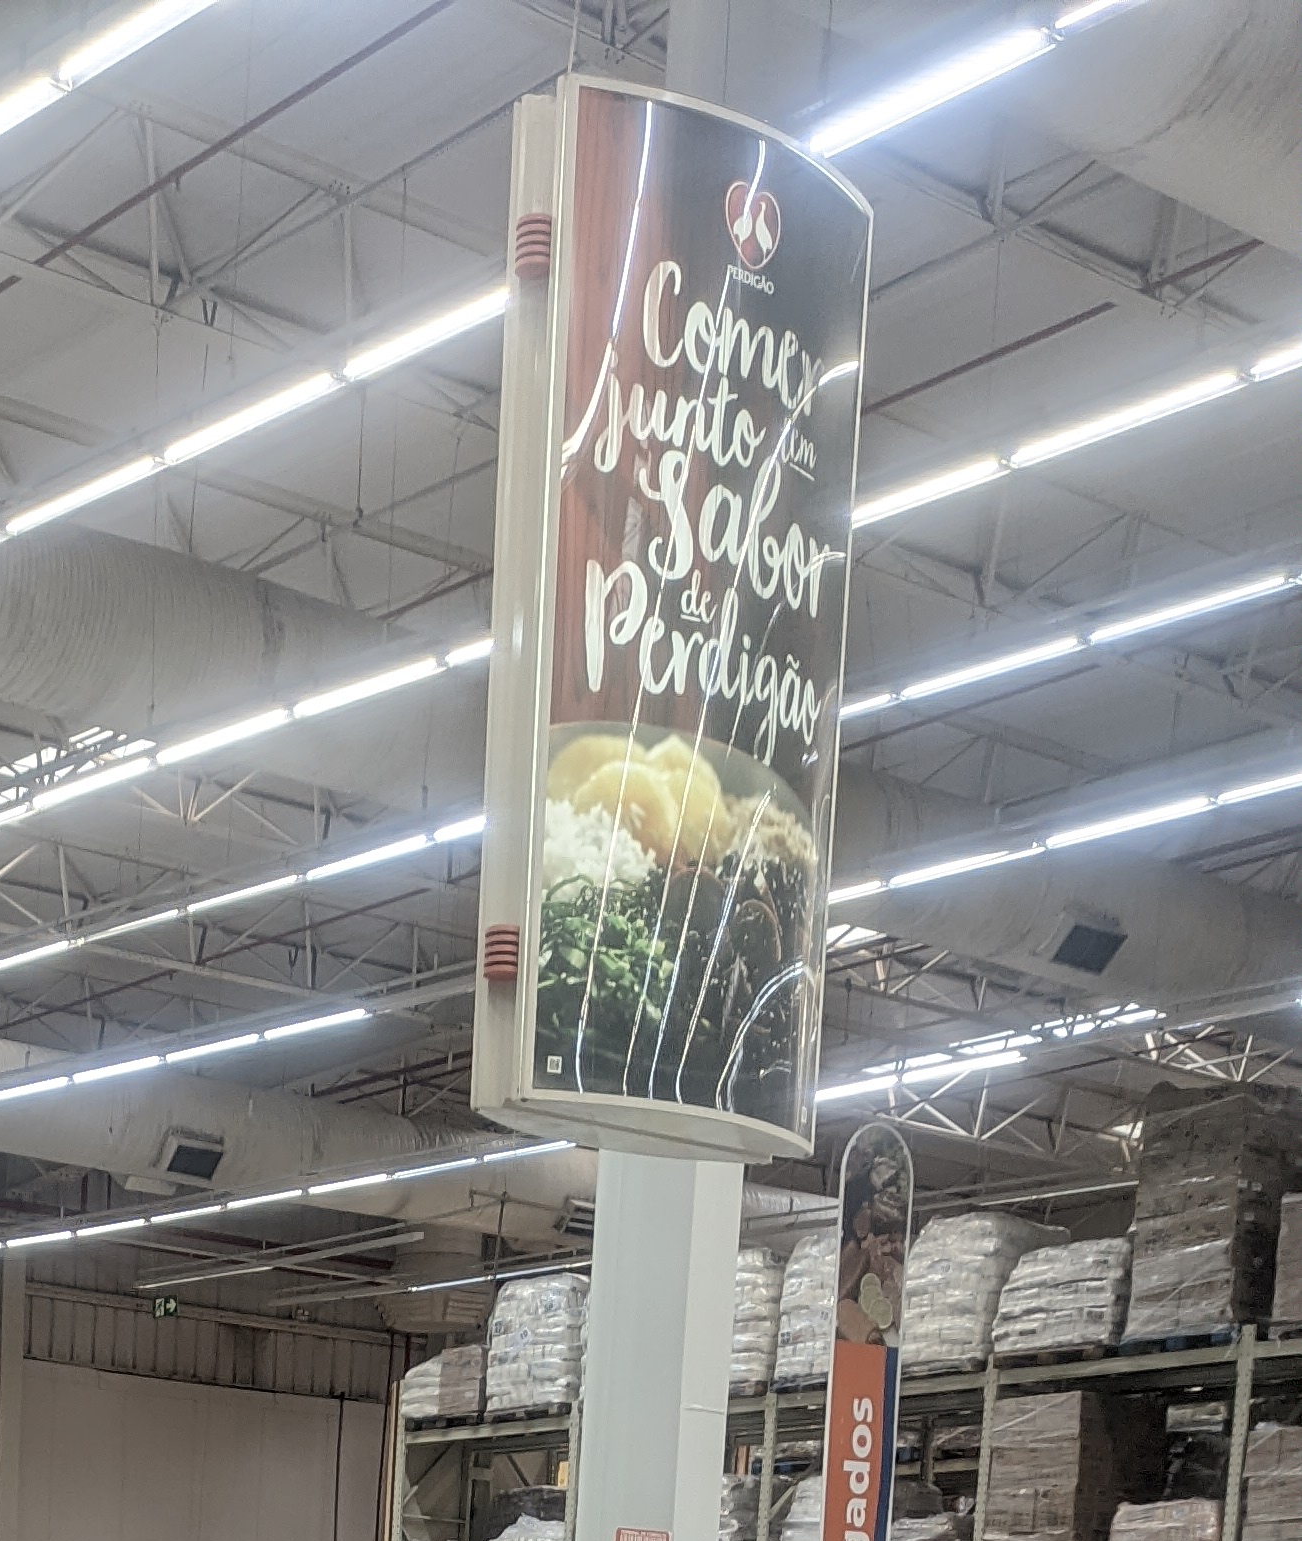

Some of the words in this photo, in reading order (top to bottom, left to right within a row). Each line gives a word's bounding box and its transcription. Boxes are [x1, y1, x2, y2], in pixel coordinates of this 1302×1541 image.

[642, 259, 826, 416] Comer
[727, 264, 775, 295] PERDIGÃO
[594, 358, 766, 474] junto
[639, 450, 832, 618] Sabor
[680, 569, 716, 620] de
